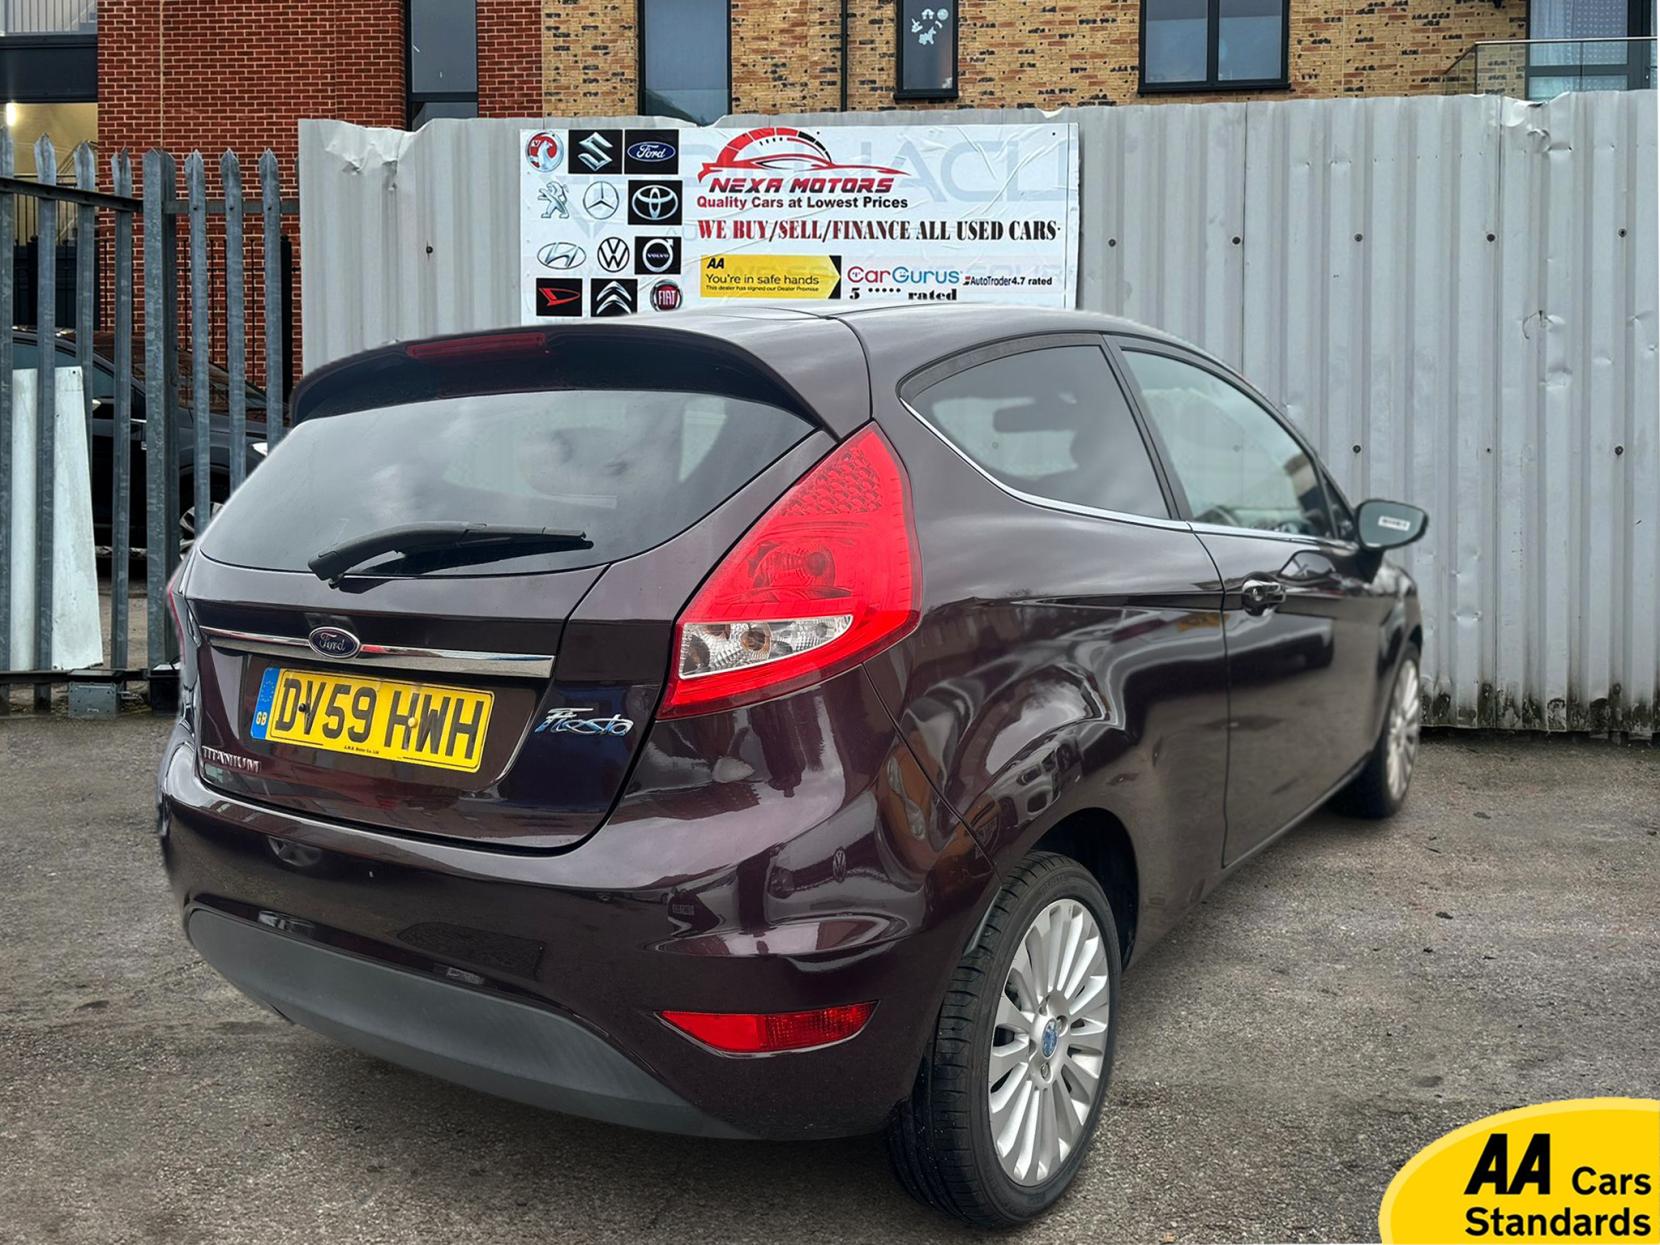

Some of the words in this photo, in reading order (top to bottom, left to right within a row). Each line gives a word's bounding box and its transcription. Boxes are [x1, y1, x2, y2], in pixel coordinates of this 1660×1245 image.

[636, 144, 666, 159] Ford
[709, 177, 783, 194] NEXA
[789, 177, 895, 194] MOTORS
[696, 196, 747, 210] Quality
[751, 196, 784, 209] Cars
[788, 197, 803, 209] at
[807, 196, 859, 209] Lowest
[863, 196, 908, 209] Prices
[697, 219, 727, 241] WE
[916, 220, 950, 241] ALL
[957, 220, 1004, 241] USED
[1008, 220, 1057, 241] CARS
[706, 257, 725, 269] AA
[705, 273, 741, 284] You're
[744, 273, 755, 284] in
[757, 273, 782, 285] safe
[783, 274, 820, 285] hands
[847, 265, 960, 284] CarGurus
[970, 275, 1011, 287] AutoTrader
[1011, 276, 1025, 286] 4.7
[1027, 276, 1053, 286] rated
[658, 289, 677, 306] FIAT
[849, 287, 861, 300] 5
[908, 288, 958, 300] rated
[319, 632, 346, 653] Ford
[255, 711, 268, 726] GB
[275, 677, 378, 744] DV59
[383, 690, 485, 760] HWH
[534, 707, 635, 737] Fiesta
[201, 745, 262, 774] TITANIUM
